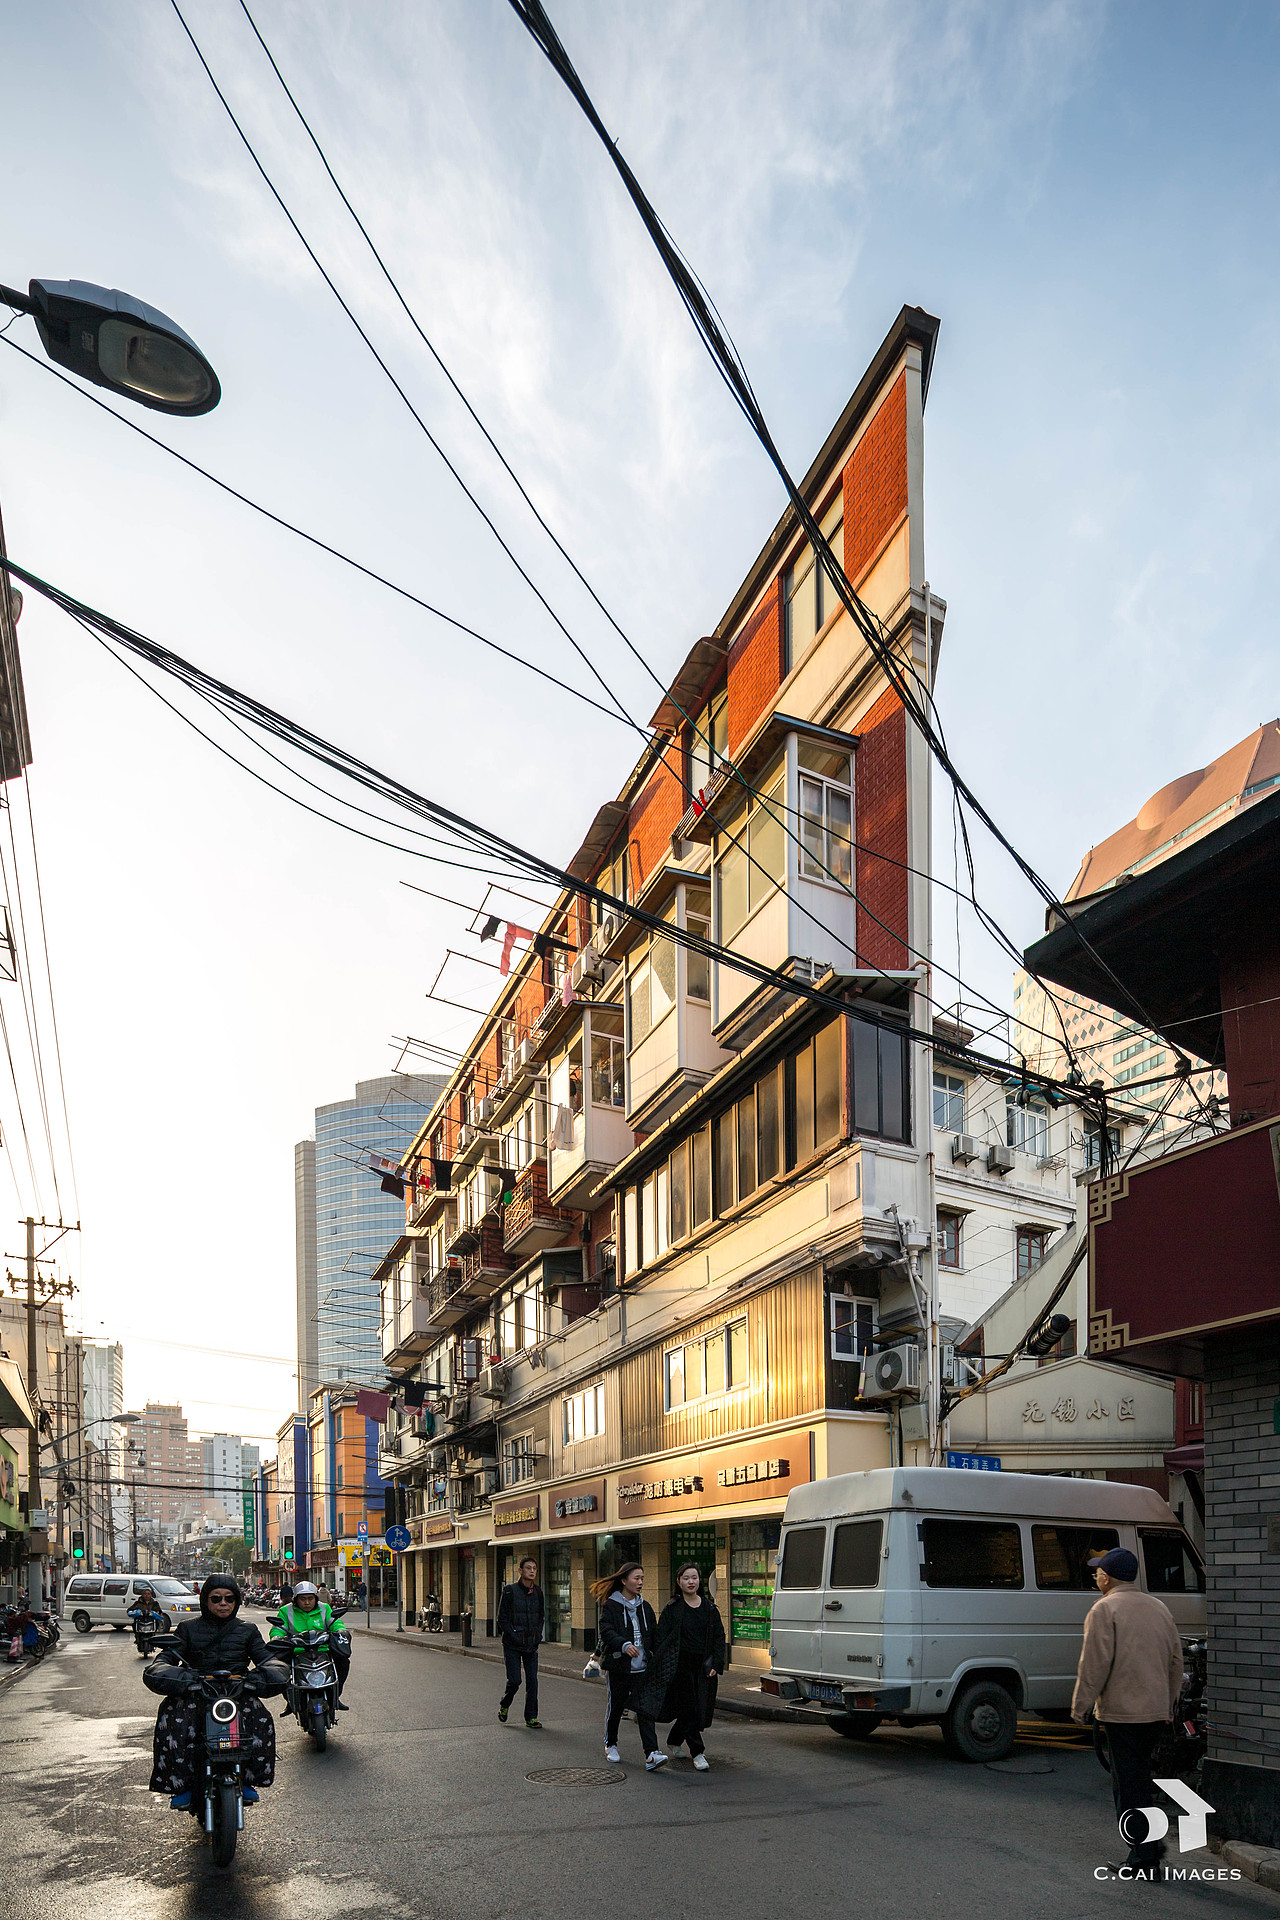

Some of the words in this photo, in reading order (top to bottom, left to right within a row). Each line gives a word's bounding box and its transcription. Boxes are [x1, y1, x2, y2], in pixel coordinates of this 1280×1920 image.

[1022, 1396, 1136, 1423] 无锡小区
[644, 1475, 697, 1499] 施耐德电气
